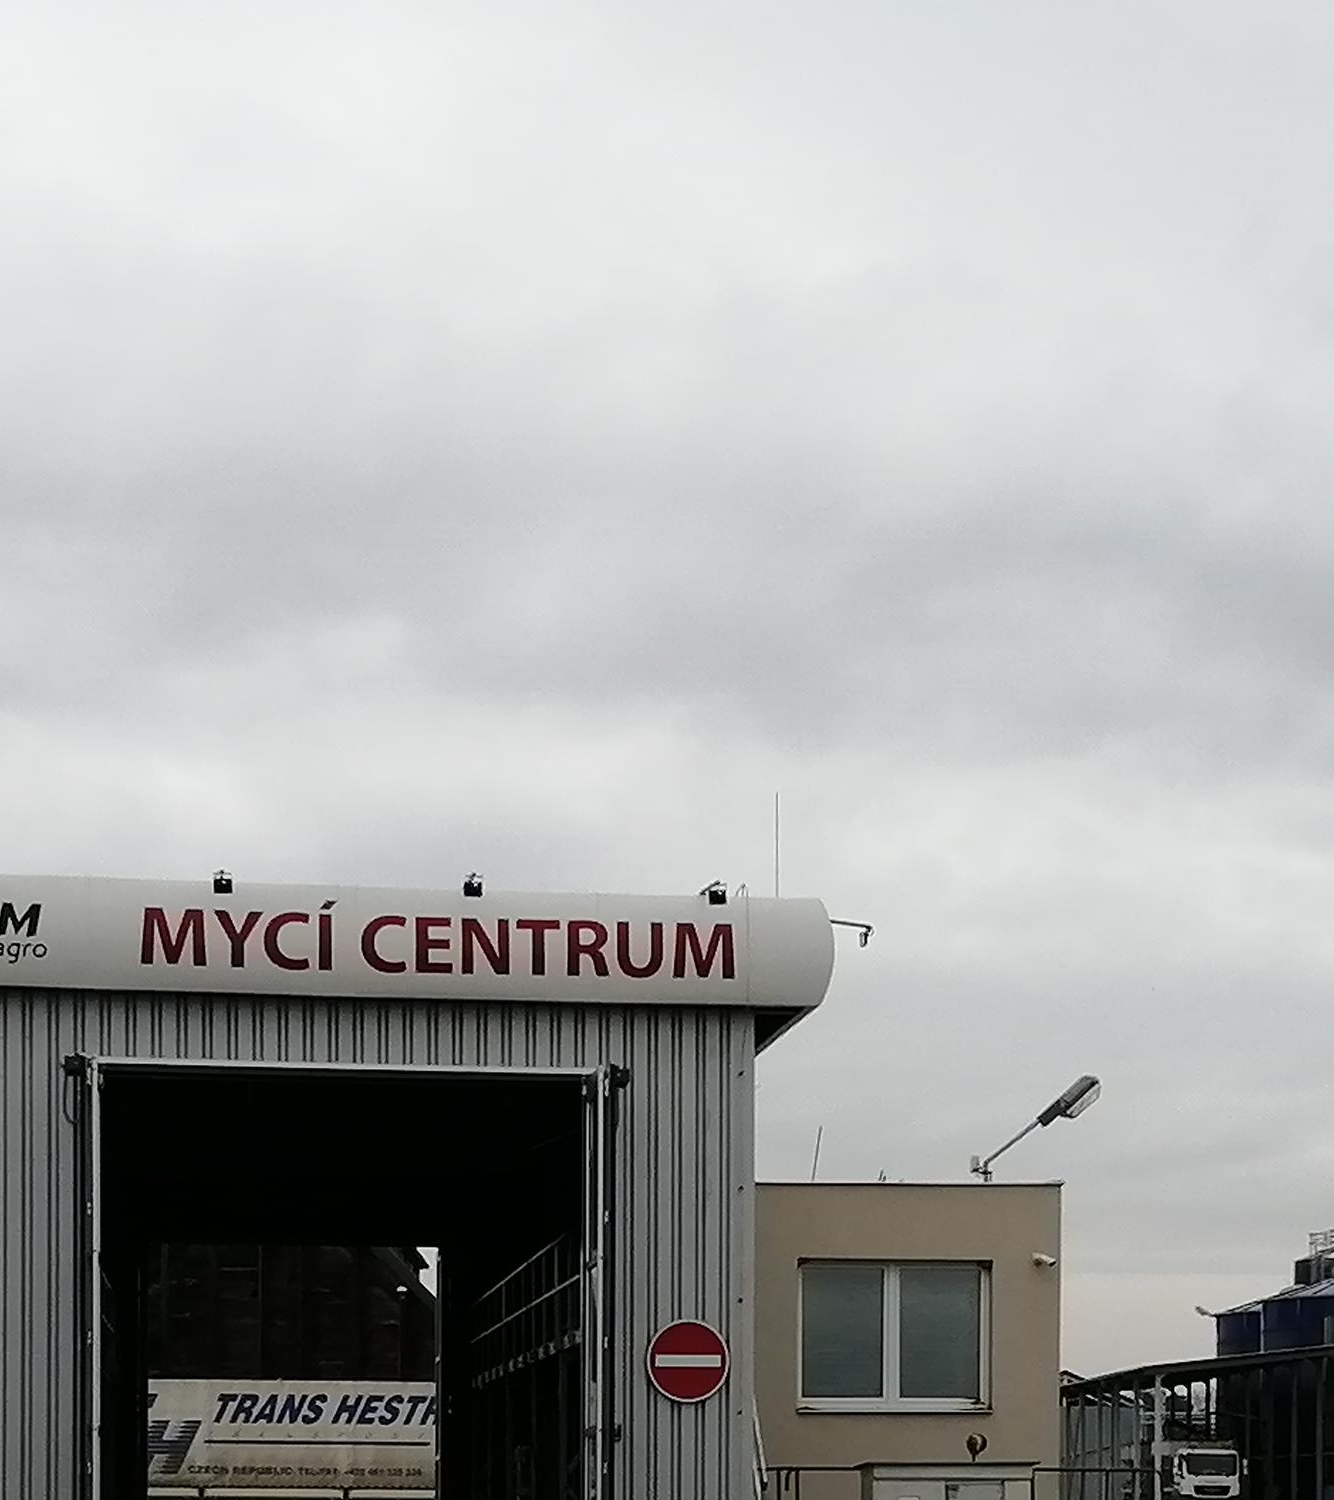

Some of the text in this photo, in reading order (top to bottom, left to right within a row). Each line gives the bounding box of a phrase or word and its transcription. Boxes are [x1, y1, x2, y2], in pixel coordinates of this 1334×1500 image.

[140, 900, 736, 980] MYCÍ CENTRUM
[213, 1393, 327, 1425] TRANS
